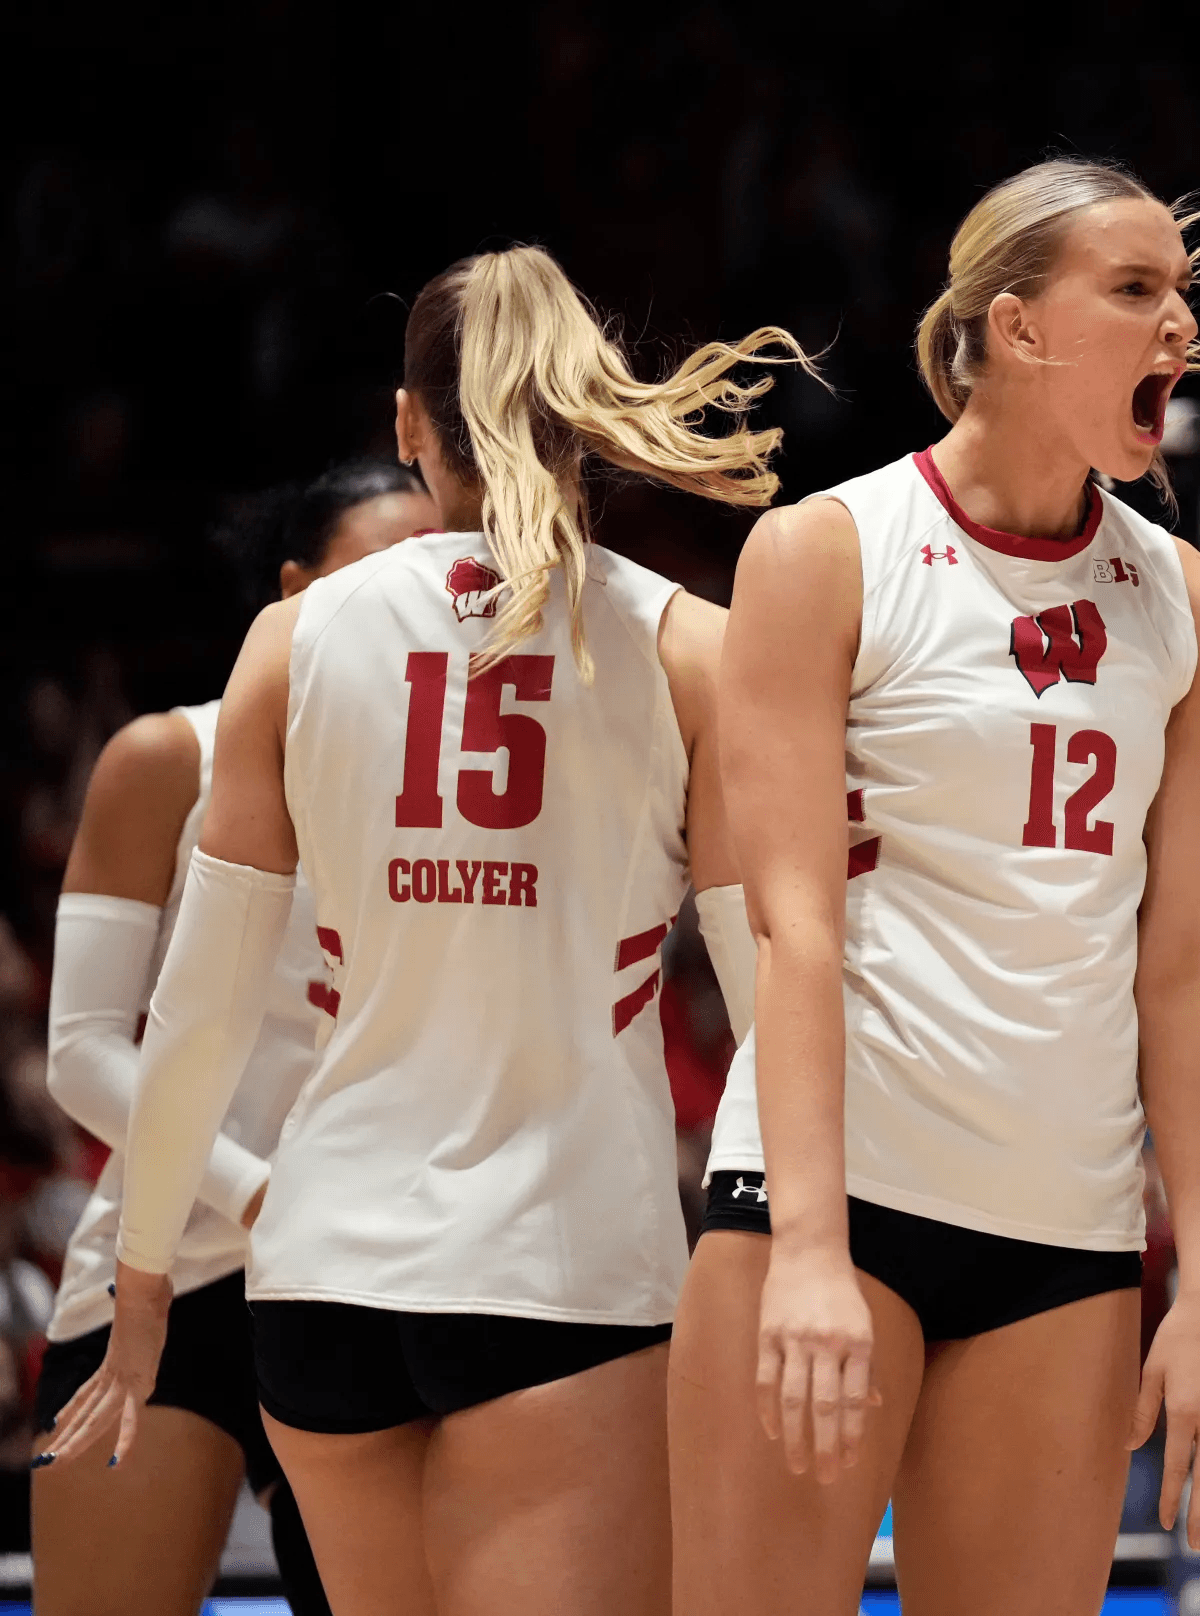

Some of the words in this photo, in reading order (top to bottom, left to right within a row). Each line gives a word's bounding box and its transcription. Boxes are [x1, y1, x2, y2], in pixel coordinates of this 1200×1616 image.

[1009, 599, 1107, 699] W
[395, 651, 555, 830] 15
[1022, 722, 1117, 856] 12
[387, 858, 538, 907] COLYER
